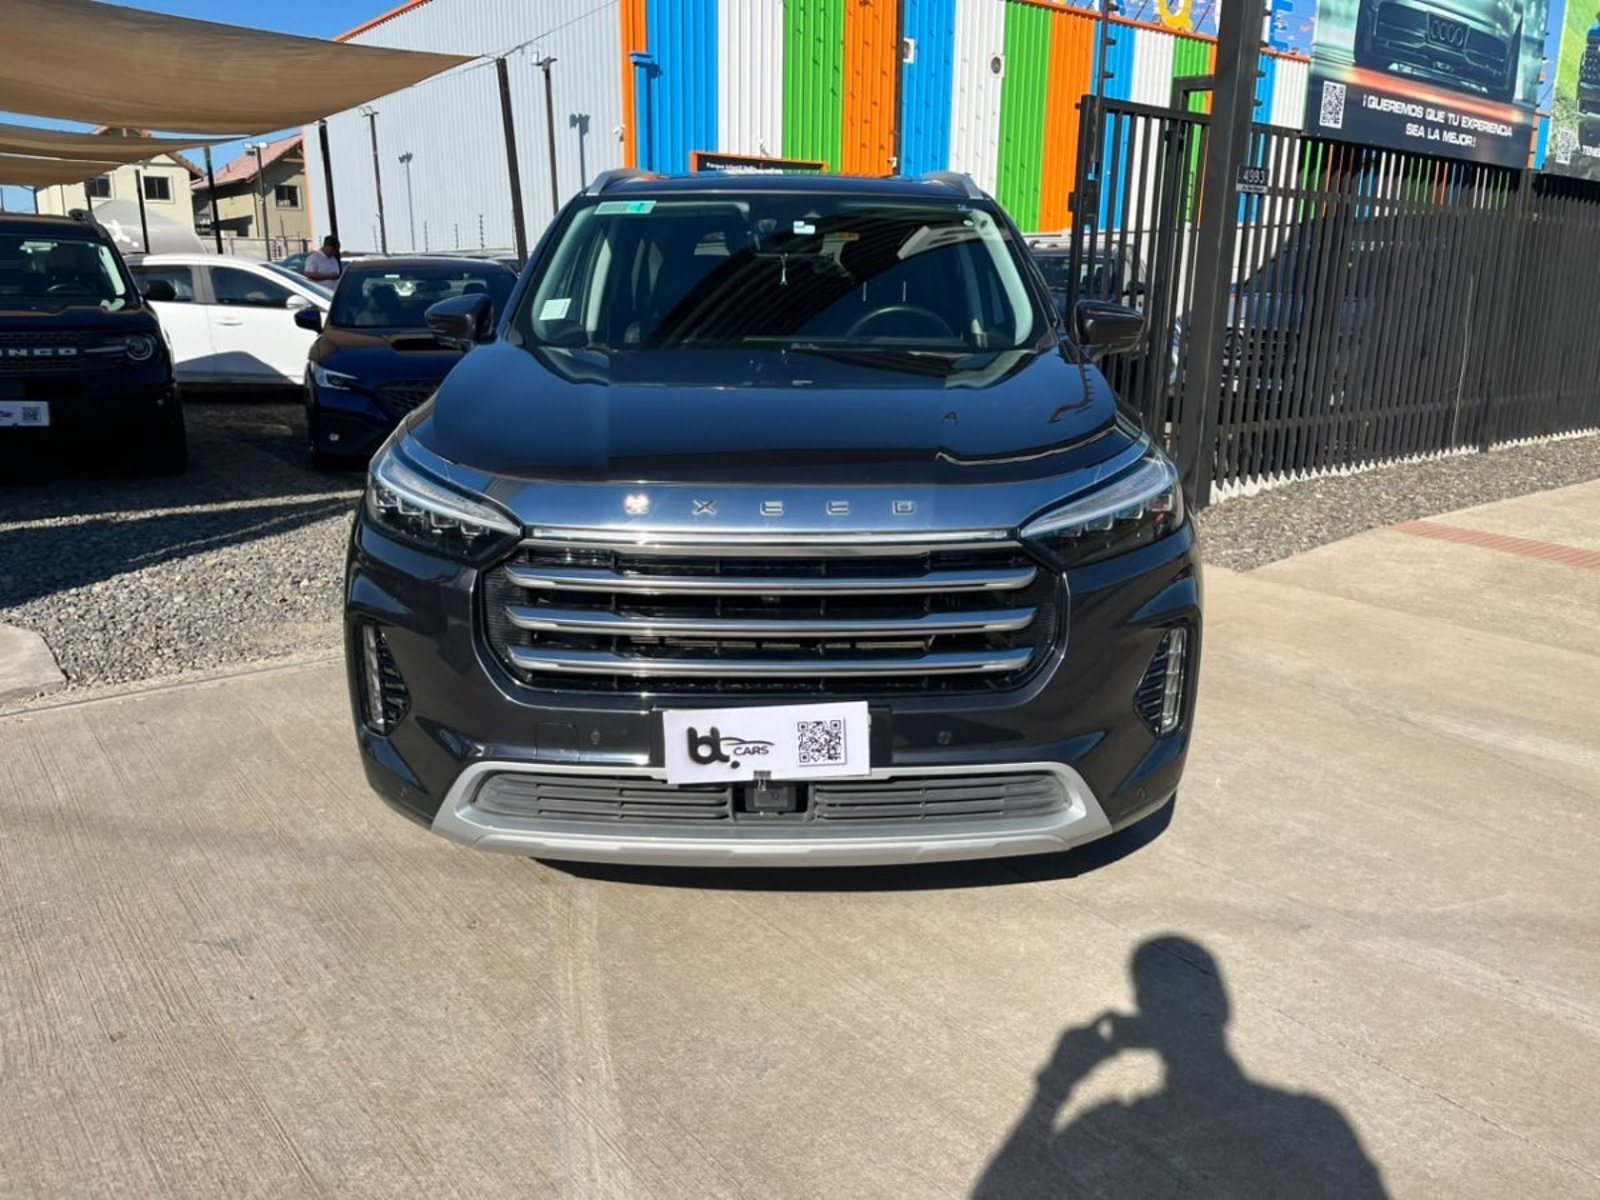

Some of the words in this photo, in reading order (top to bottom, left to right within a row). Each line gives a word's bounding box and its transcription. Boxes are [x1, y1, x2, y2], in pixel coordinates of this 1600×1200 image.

[1425, 107, 1445, 124] QUE
[1447, 113, 1460, 128] TU
[1461, 116, 1513, 137] EXPERIENCIA
[1405, 123, 1425, 137] SEA
[1427, 127, 1440, 141] LA
[1442, 130, 1477, 147] MEJOR!
[0, 348, 77, 357] NCO
[733, 745, 769, 756] CARS
